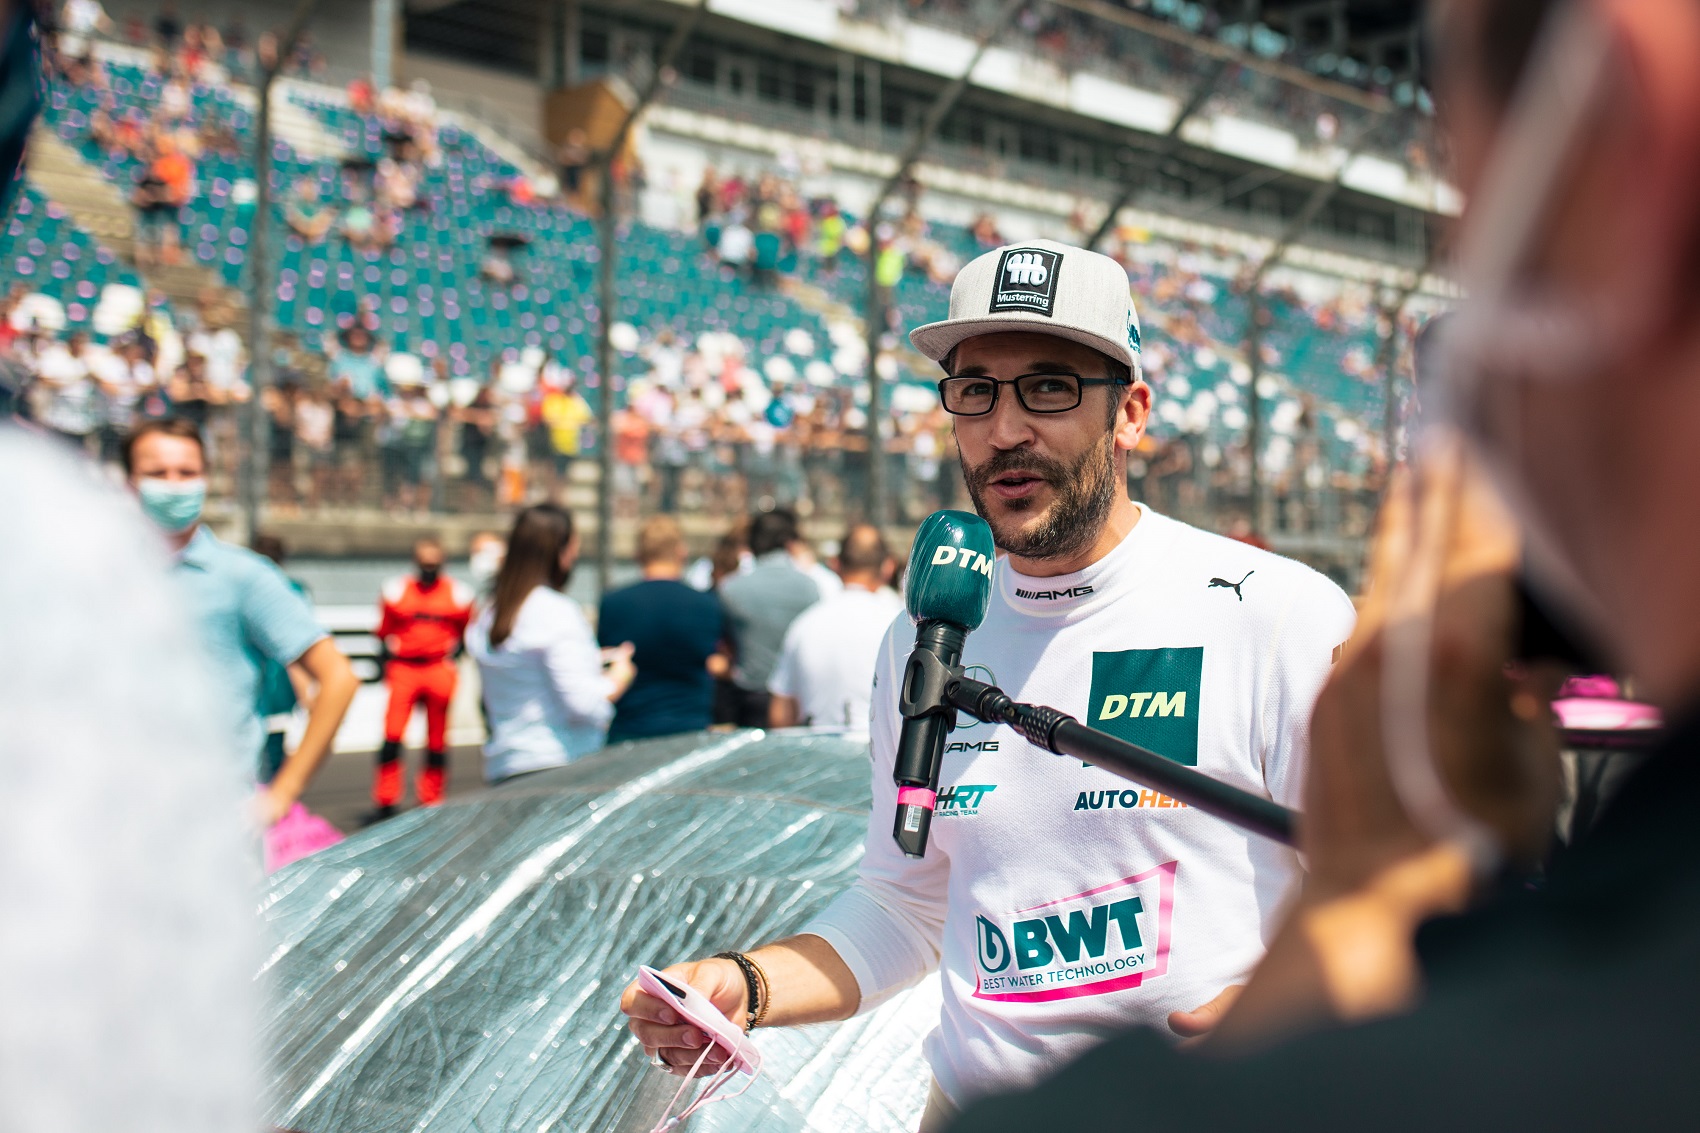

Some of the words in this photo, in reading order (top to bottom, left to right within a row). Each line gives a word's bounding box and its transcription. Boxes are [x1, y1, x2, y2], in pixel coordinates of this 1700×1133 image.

[996, 293, 1049, 308] Musterring
[931, 545, 994, 581] DTM
[1034, 585, 1094, 601] AMG
[1098, 691, 1187, 721] DTM
[945, 741, 1000, 754] AMG
[1013, 896, 1144, 971] BWT
[983, 977, 1006, 990] BEST
[1008, 973, 1044, 988] WATER
[1047, 953, 1146, 983] TECHNOLOGY
